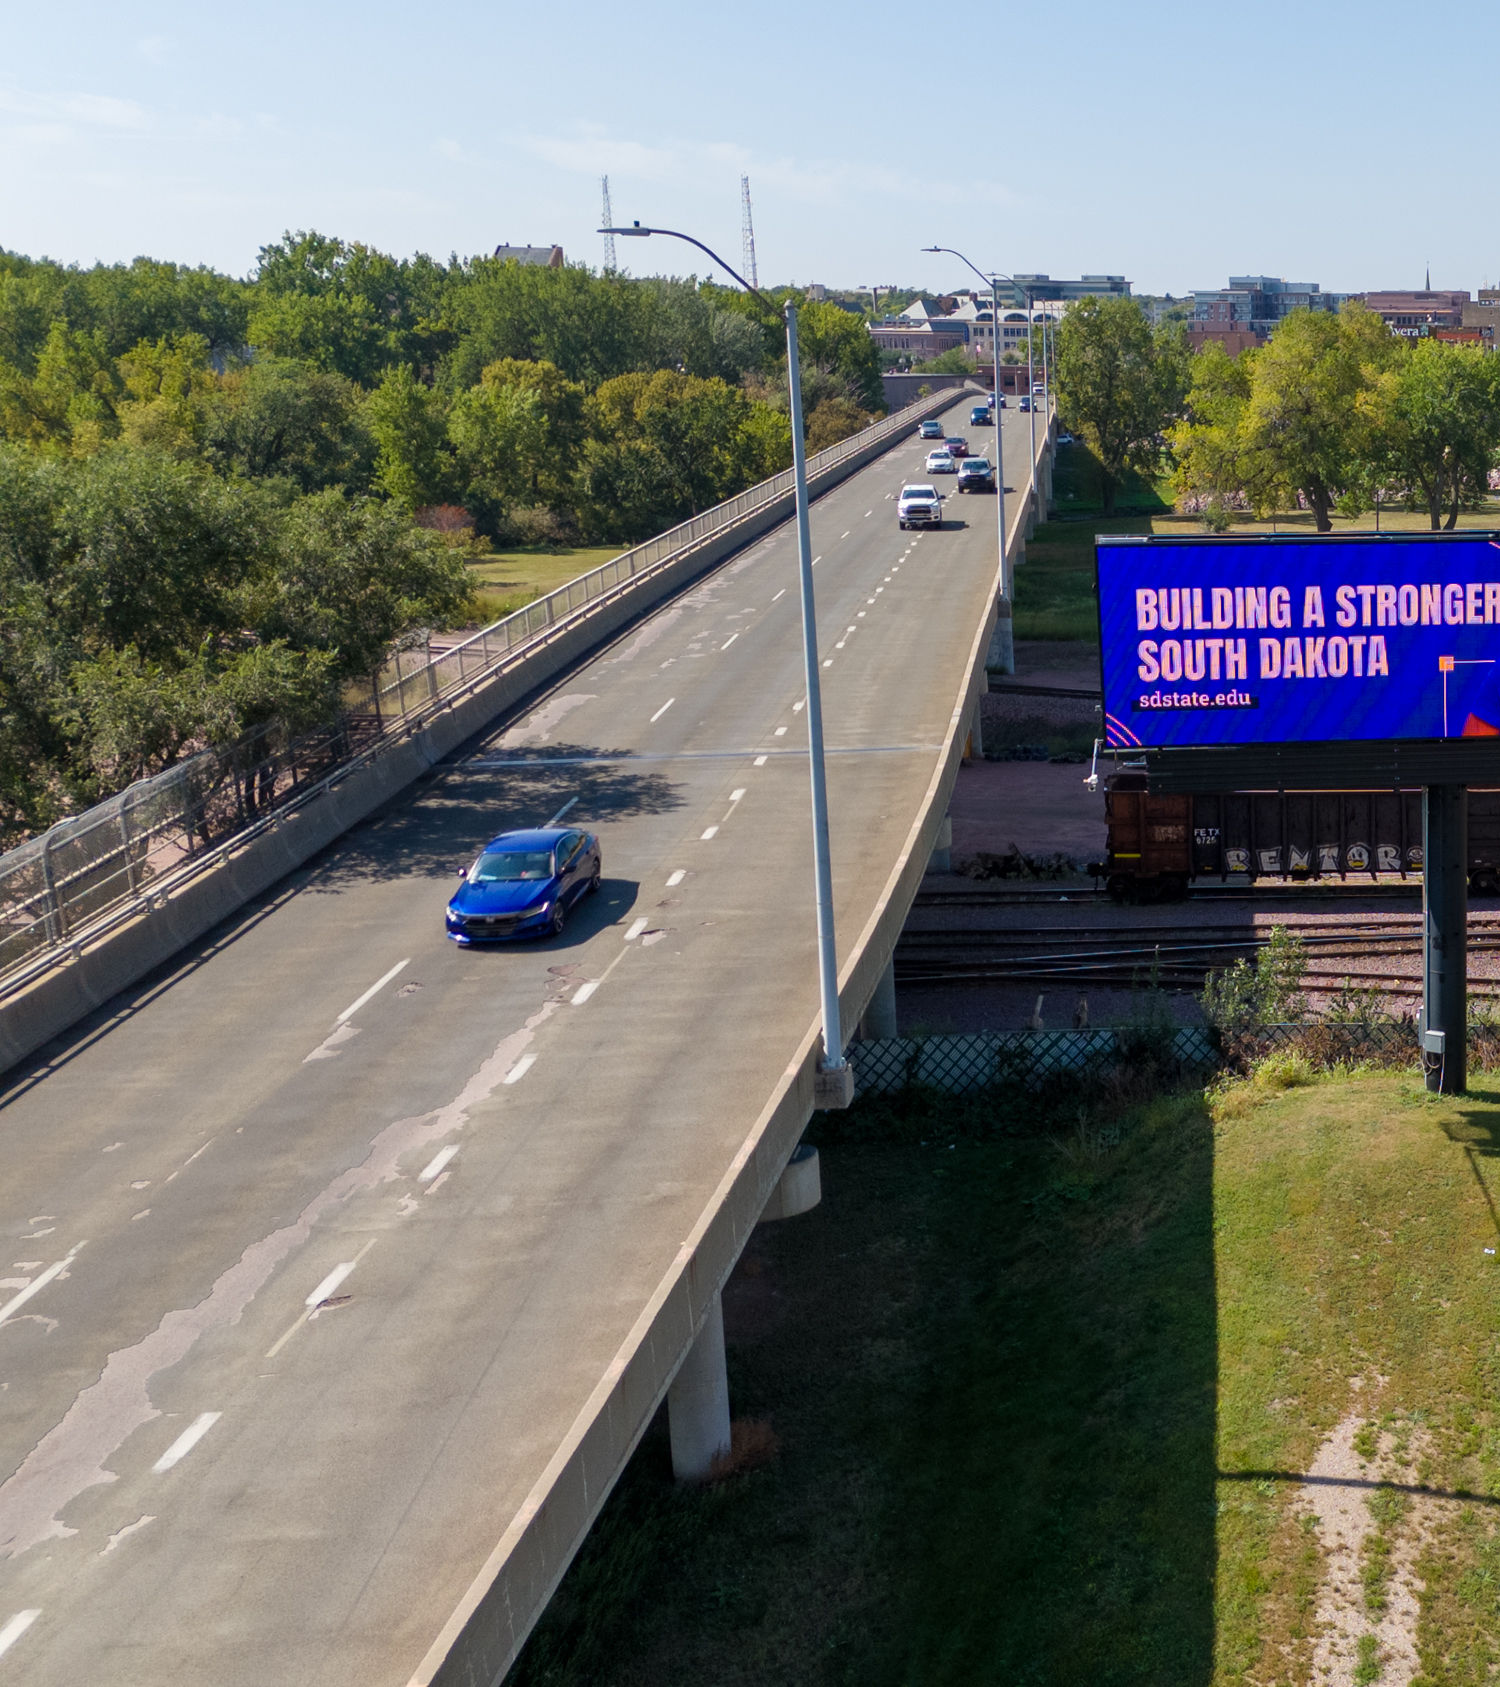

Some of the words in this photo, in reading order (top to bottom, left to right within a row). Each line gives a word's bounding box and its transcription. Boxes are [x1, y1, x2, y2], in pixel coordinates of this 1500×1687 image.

[1135, 586, 1292, 631] BUILDING
[1302, 585, 1325, 628] A
[1137, 638, 1248, 682] SOUTH
[1259, 635, 1389, 680] DAKOTA
[1139, 689, 1251, 709] sdstate.edu
